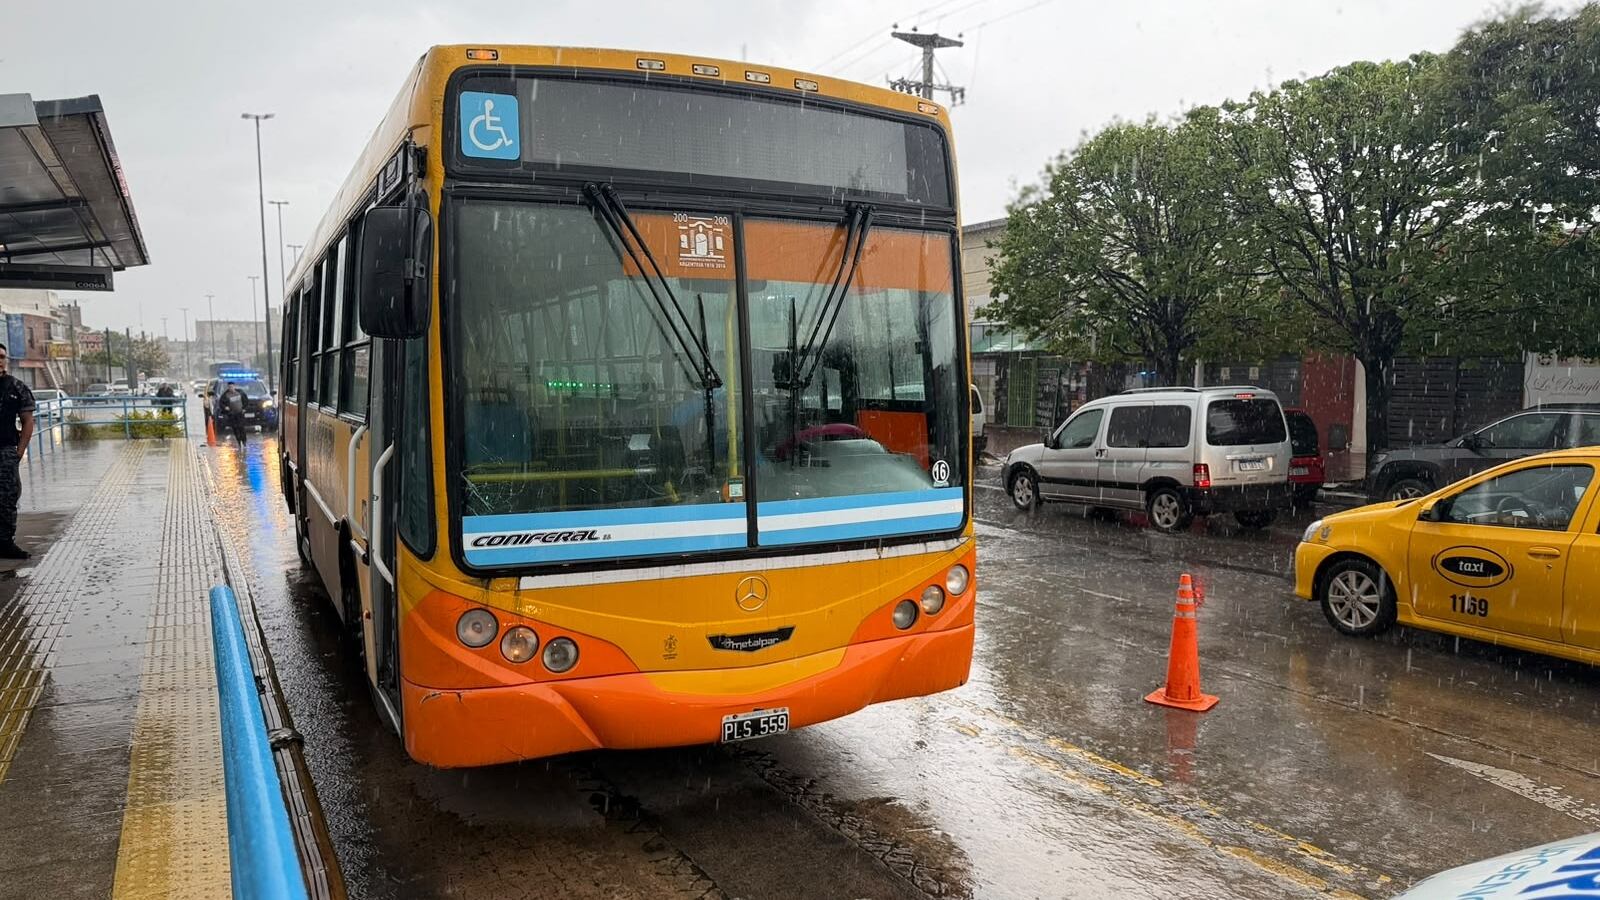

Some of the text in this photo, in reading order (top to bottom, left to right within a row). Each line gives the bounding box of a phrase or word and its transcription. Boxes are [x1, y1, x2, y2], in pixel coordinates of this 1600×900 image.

[673, 212, 688, 223] 200
[714, 215, 728, 226] 200
[935, 463, 946, 480] 16
[472, 530, 600, 547] CONIFERAL
[1458, 560, 1485, 573] taxi
[1449, 594, 1488, 617] 1169
[732, 638, 779, 649] metalpar
[724, 715, 787, 741] PLS 559
